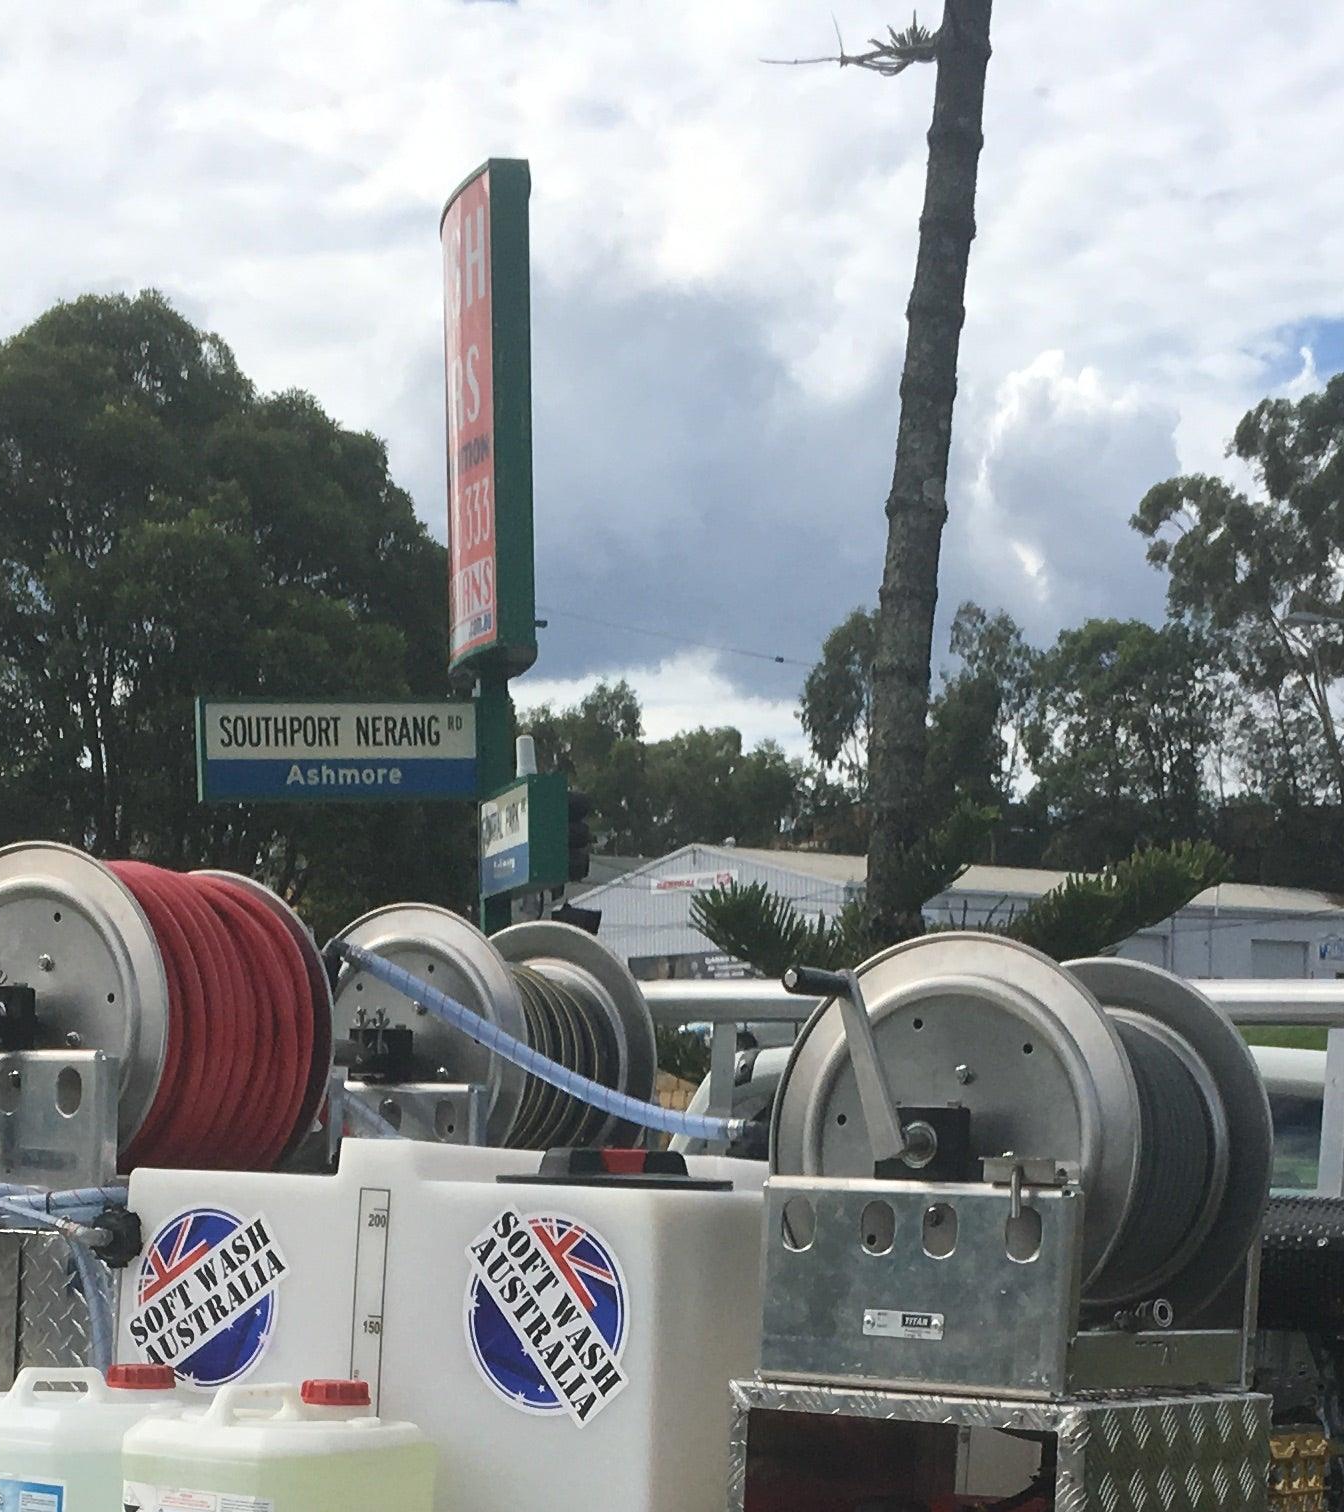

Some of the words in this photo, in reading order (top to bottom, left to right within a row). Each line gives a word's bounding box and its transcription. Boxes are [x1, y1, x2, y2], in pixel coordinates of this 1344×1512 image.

[218, 714, 342, 748] SOUTHPORT
[355, 714, 441, 747] NERANG
[447, 714, 463, 732] RD
[285, 764, 403, 786] Ashmore
[367, 1214, 387, 1228] 200
[128, 1280, 194, 1348] SOFT
[193, 1218, 271, 1293] WASH
[144, 1249, 287, 1366] AUSTRALIA
[492, 1211, 560, 1296] SOFT
[551, 1292, 623, 1398] WASH
[903, 1316, 929, 1326] TITAN
[362, 1320, 382, 1335] 150
[470, 1237, 598, 1422] AUSTRALIA
